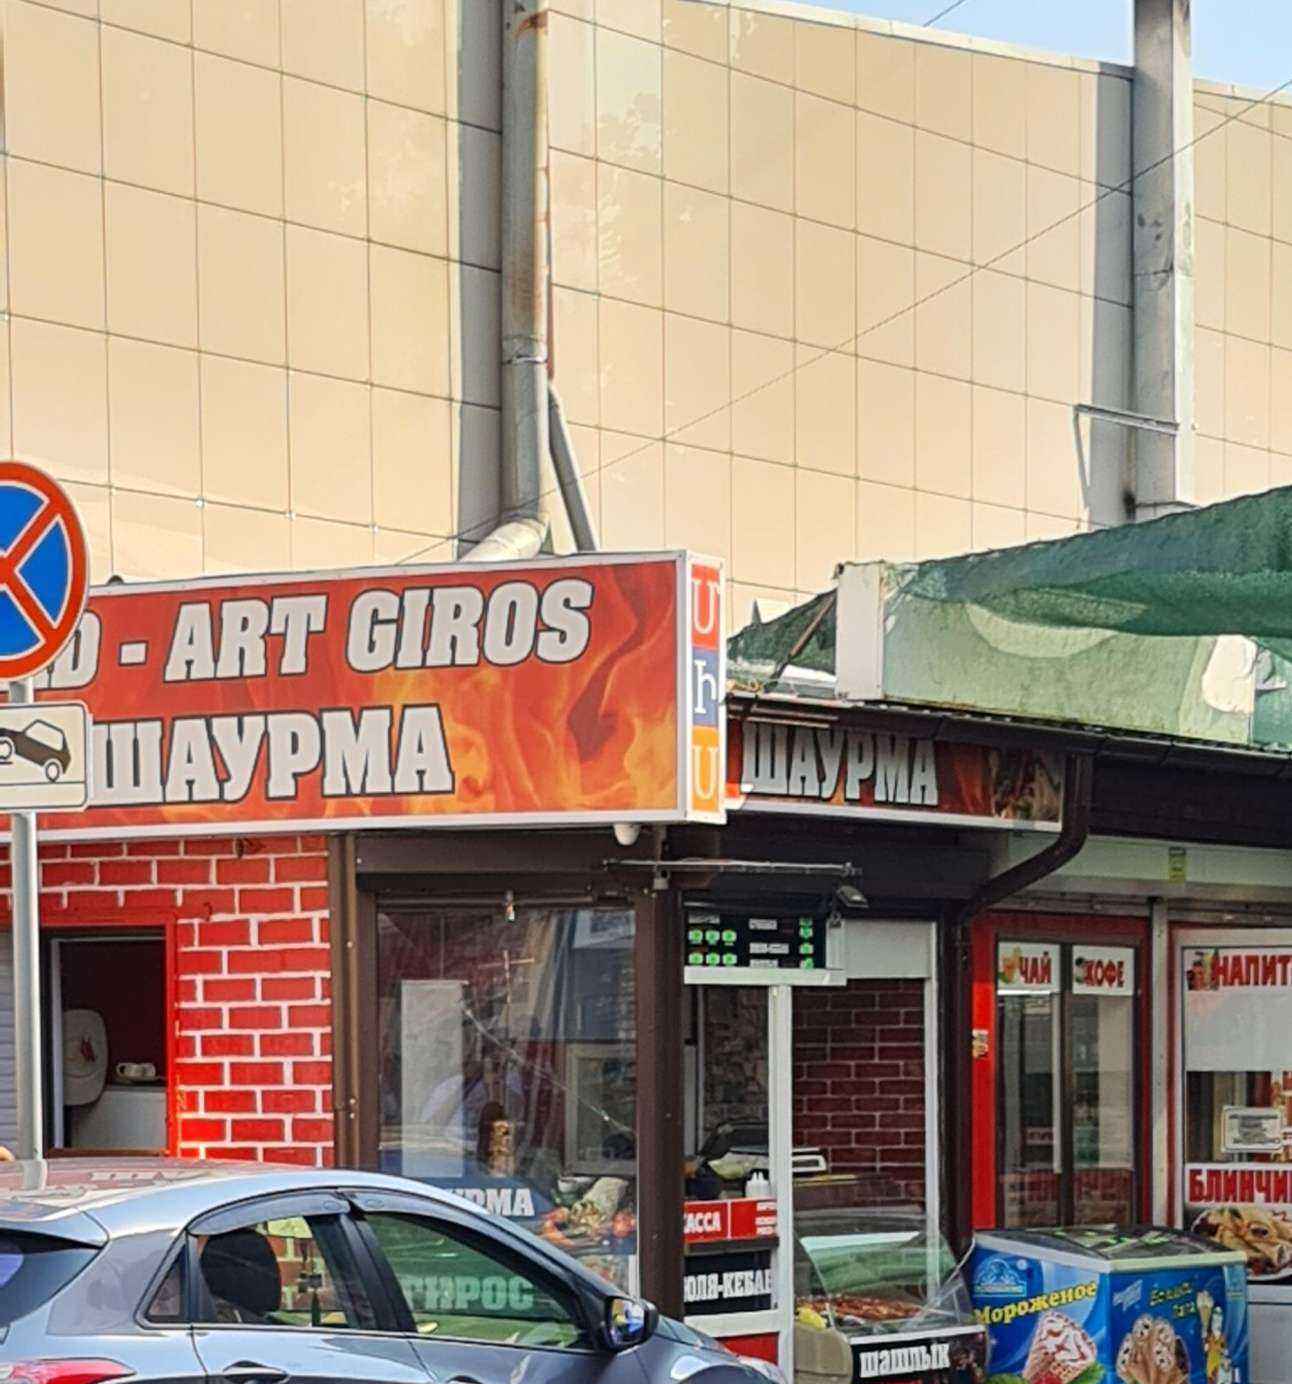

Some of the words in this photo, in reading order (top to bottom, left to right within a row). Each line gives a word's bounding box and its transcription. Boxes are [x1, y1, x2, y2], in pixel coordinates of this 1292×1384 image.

[33, 609, 102, 690] D
[163, 594, 329, 683] ART
[345, 577, 595, 674] GIROS
[88, 702, 456, 807] ШАУРМА
[741, 718, 939, 807] ШАУРМА
[1019, 951, 1052, 985] ЧАЙ
[1083, 959, 1125, 988] КОФЕ
[450, 1188, 536, 1217] РМА
[973, 1280, 1097, 1325] Мороженое
